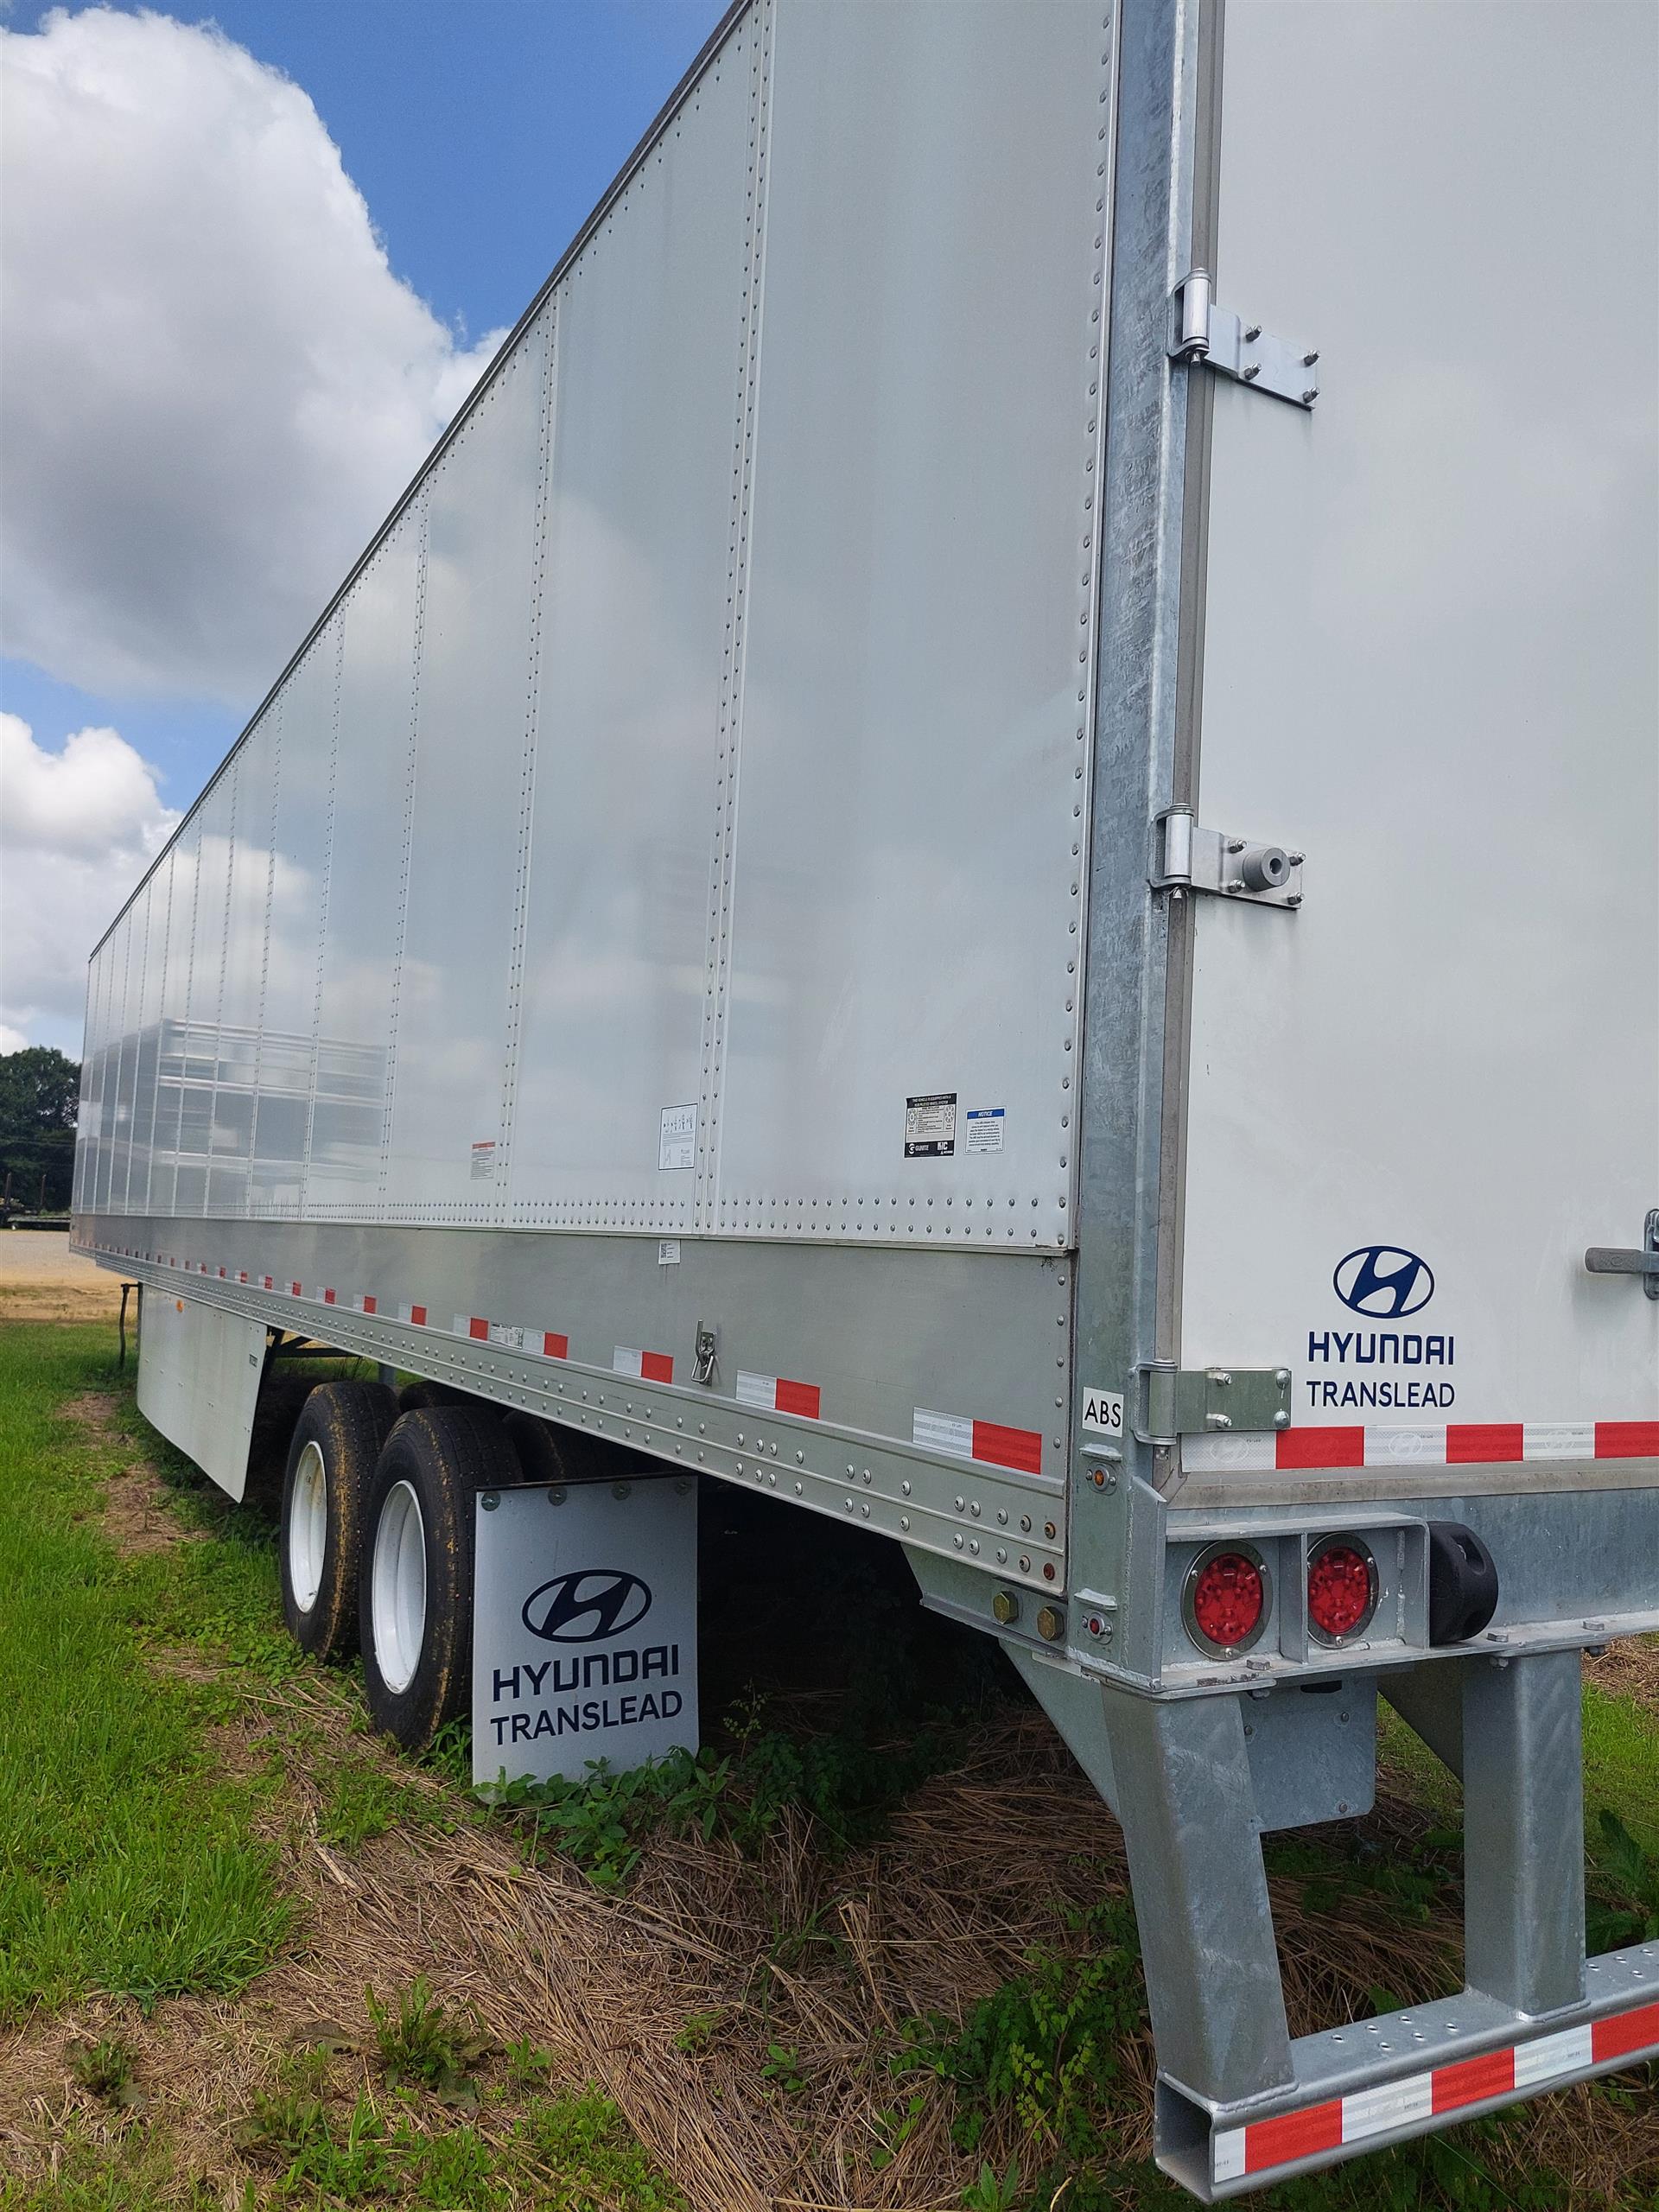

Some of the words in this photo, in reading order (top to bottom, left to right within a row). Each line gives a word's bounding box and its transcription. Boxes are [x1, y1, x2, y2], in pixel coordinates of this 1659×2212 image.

[1307, 1332, 1455, 1366] HYUNDAI
[1306, 1381, 1455, 1408] TRANSLEAD
[1084, 1397, 1121, 1428] ABS
[493, 1643, 679, 1702] HYUNDAI
[490, 1690, 683, 1745] TRANSLEAD
